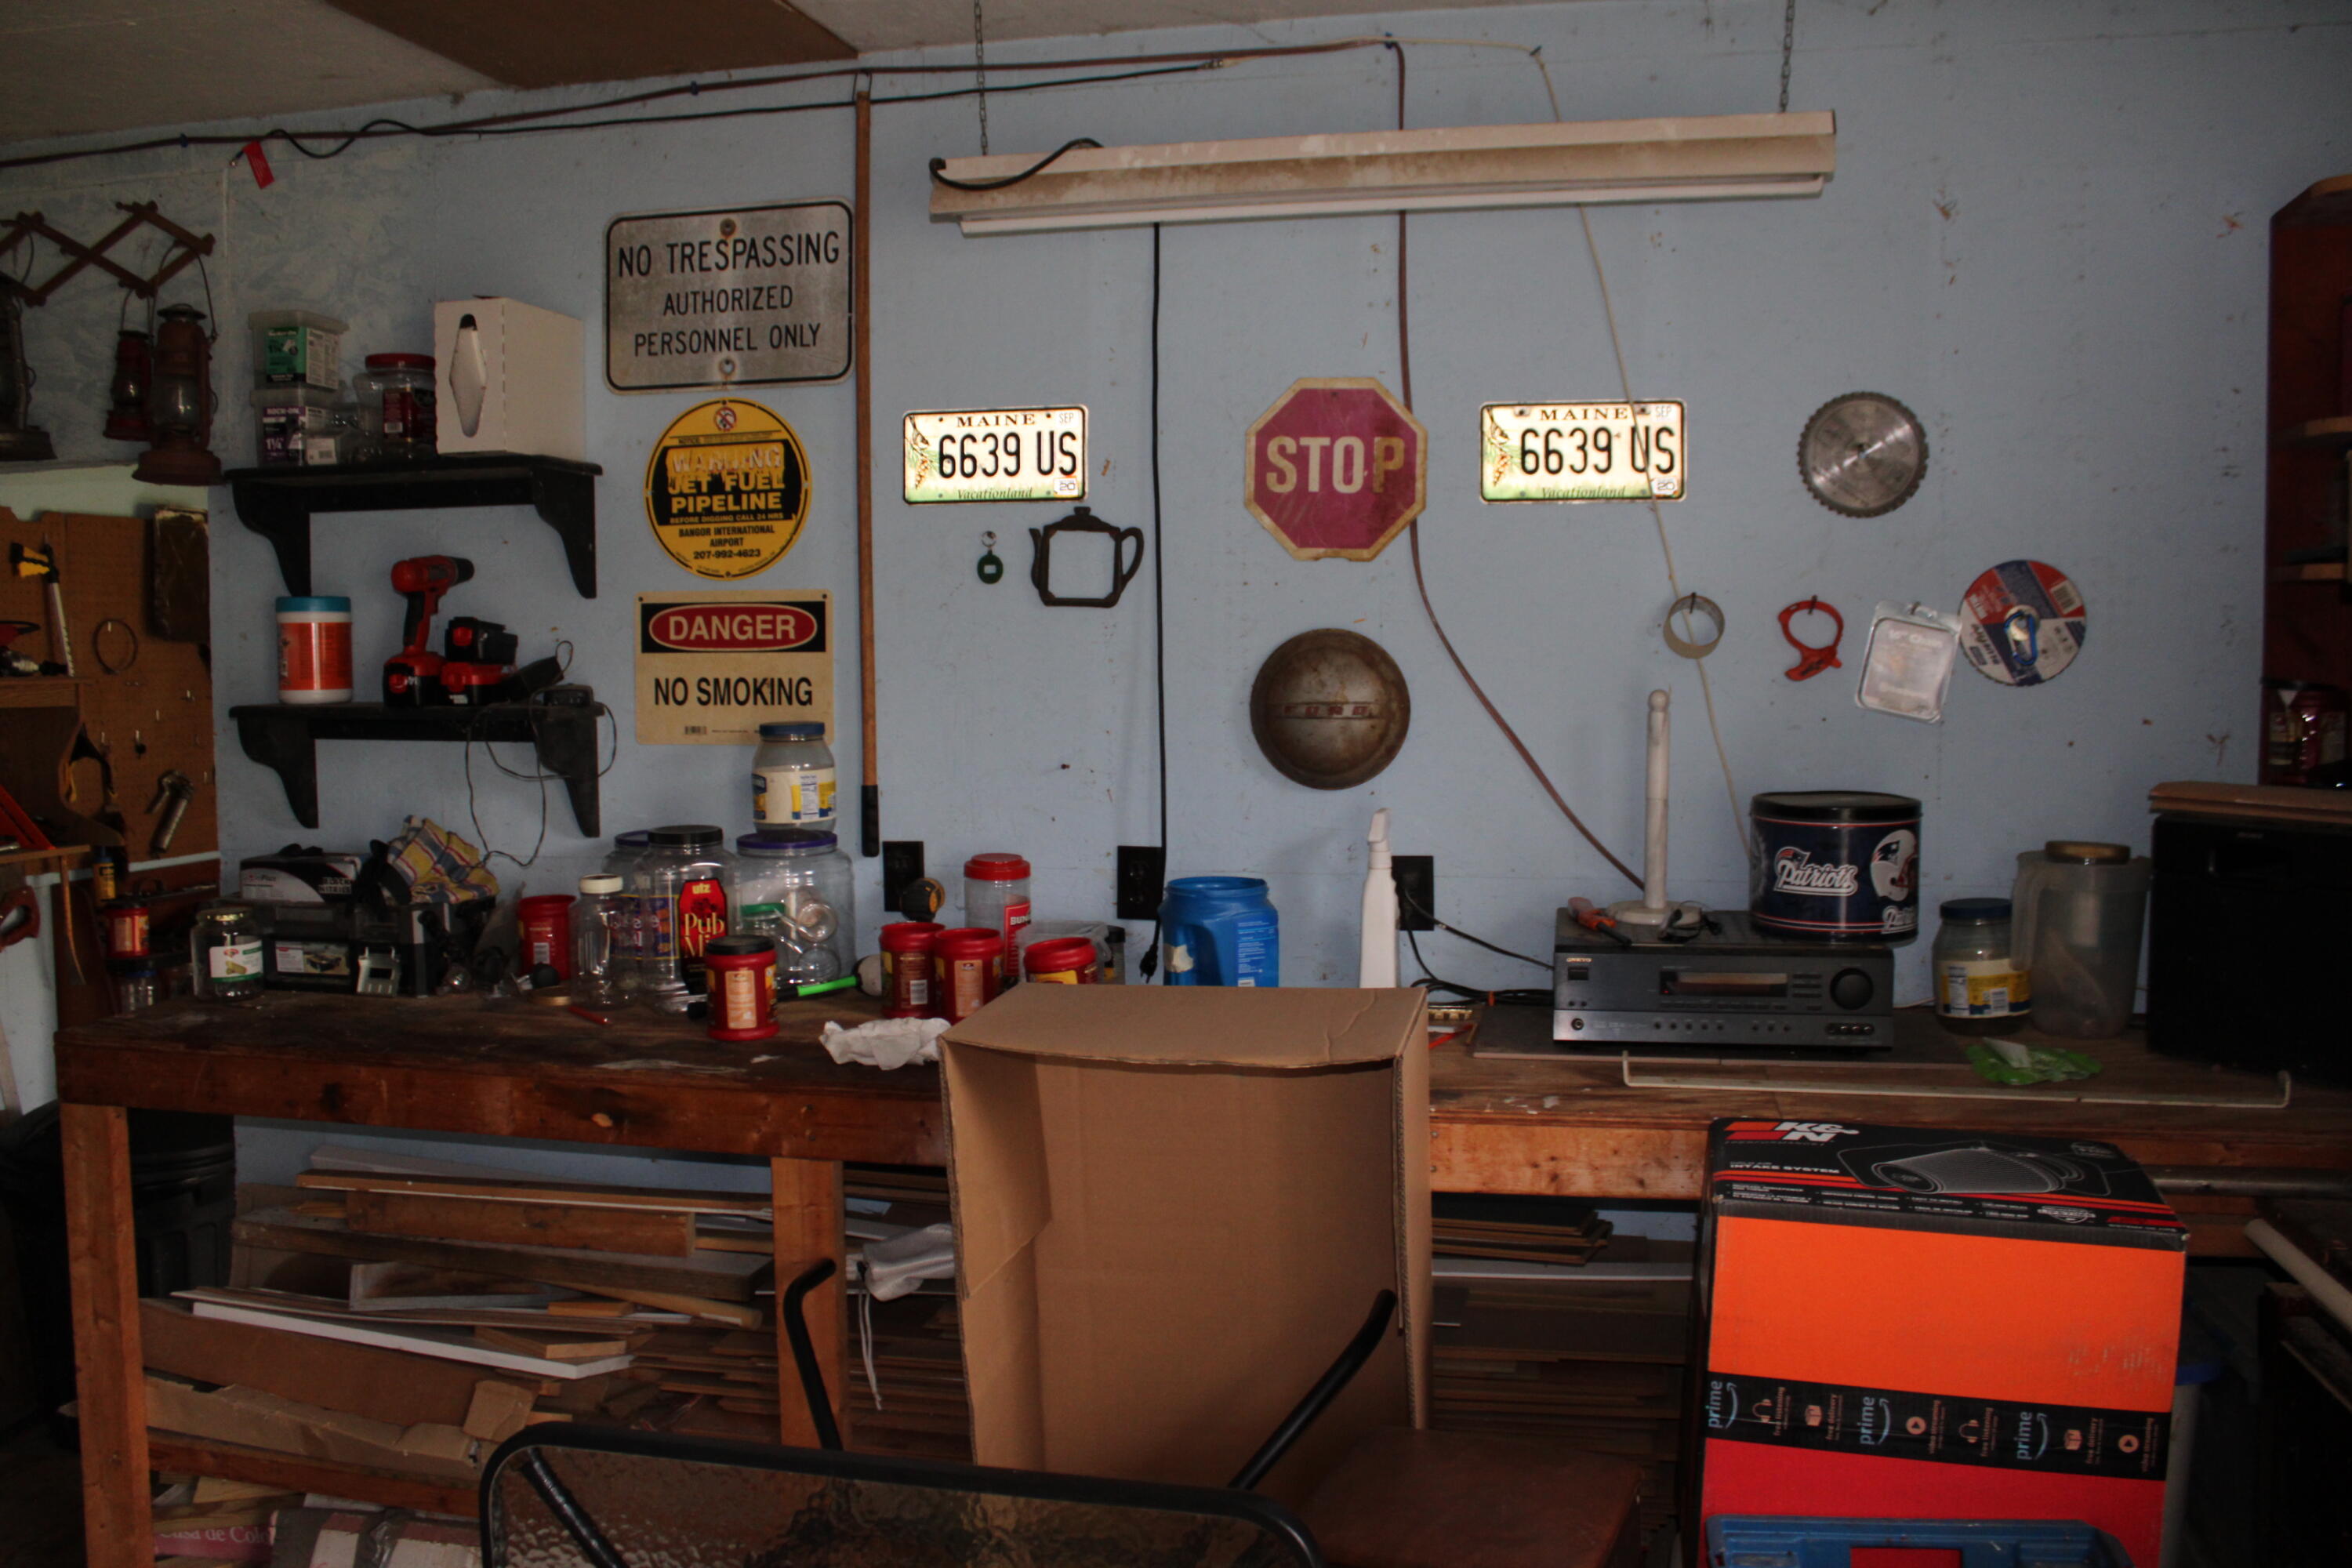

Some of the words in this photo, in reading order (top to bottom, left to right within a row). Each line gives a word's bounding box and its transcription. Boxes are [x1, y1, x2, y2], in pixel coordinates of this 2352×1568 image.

[619, 245, 652, 278] NO
[666, 231, 840, 274] TRESPASSING
[663, 285, 793, 317] AUTHORIZED
[634, 328, 758, 357] PERSONNEL
[769, 323, 821, 349] ONLY
[956, 413, 1036, 428] MAINE
[1058, 412, 1074, 424] SEP
[1540, 407, 1629, 421] MAINE
[1655, 405, 1671, 419] SEP
[938, 431, 1021, 478] 6639
[1036, 430, 1077, 476] US
[1520, 426, 1613, 475] 6639
[1631, 425, 1675, 474] US
[1266, 436, 1405, 494] STOP
[668, 473, 710, 494] JET
[724, 470, 786, 492] FUEL
[957, 486, 1033, 500] Vacationland
[1058, 481, 1076, 492] 20
[1541, 485, 1627, 499] Vacationland
[671, 492, 782, 514] PIPELINE
[670, 516, 699, 524] BEFORE
[701, 514, 734, 523] DIGGING
[678, 527, 712, 538] BANGOR
[713, 524, 775, 535] INTERNATIONAL
[710, 537, 744, 547] AIRPORT
[669, 615, 797, 641] DANGER
[654, 677, 689, 706] NO
[696, 677, 813, 706] SMOKING
[1776, 861, 1858, 891] Patriots
[691, 883, 711, 895] utz
[684, 912, 725, 936] Pub
[1783, 1166, 1841, 1174] SYSTEM
[1704, 1381, 1724, 1429] prime
[1857, 1396, 1876, 1445] prime
[2013, 1411, 2033, 1460] prime
[205, 1529, 227, 1541] de
